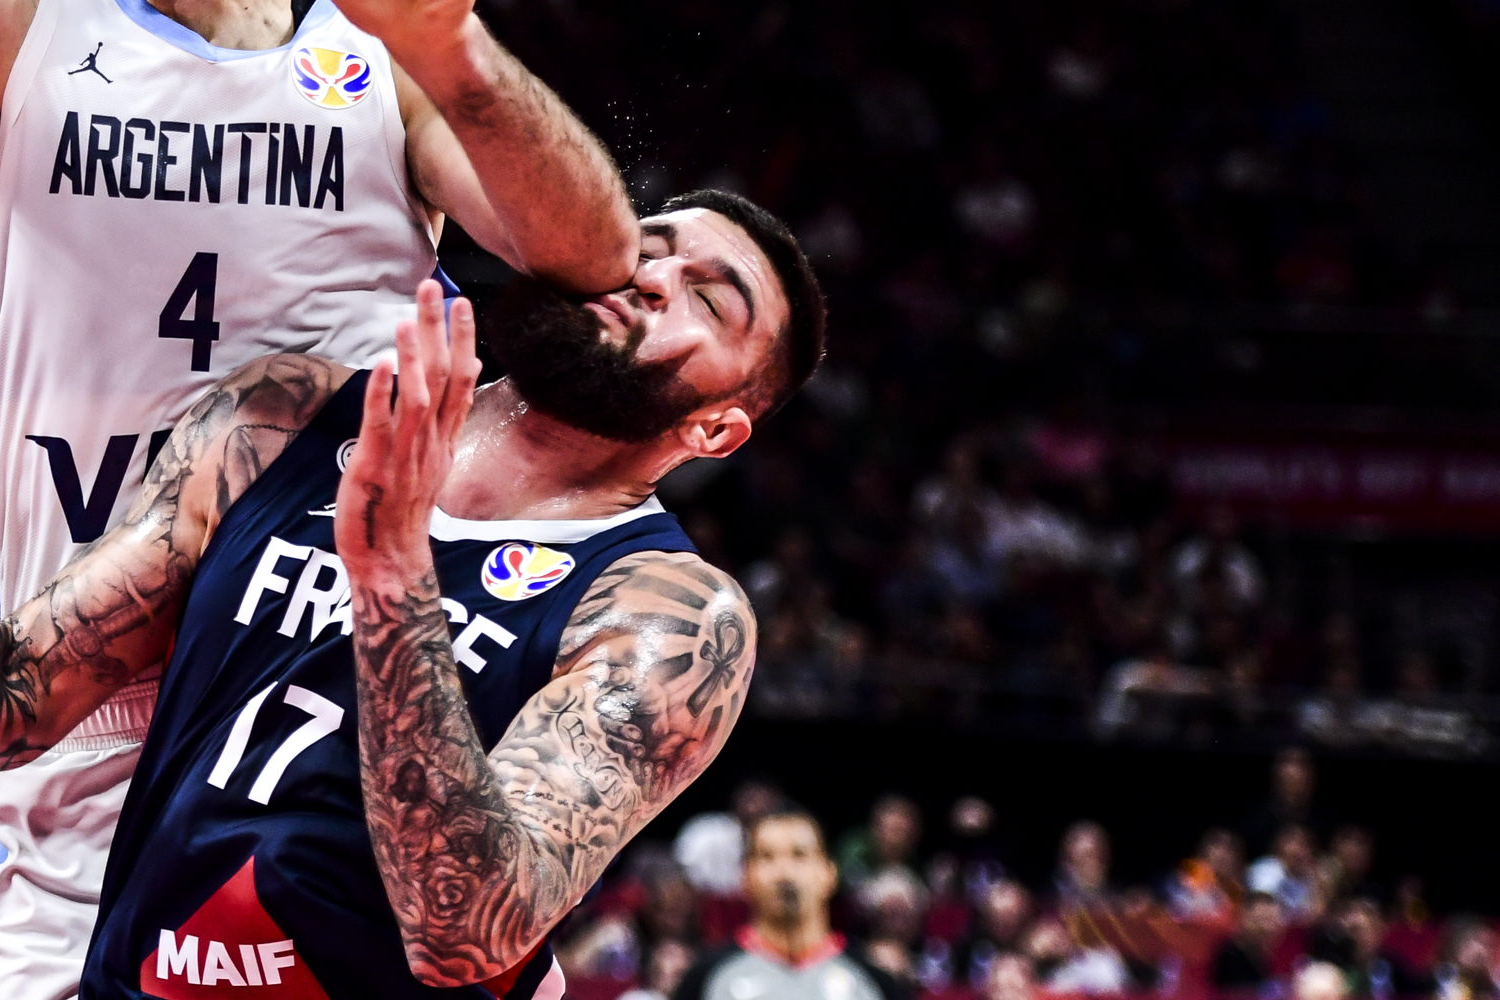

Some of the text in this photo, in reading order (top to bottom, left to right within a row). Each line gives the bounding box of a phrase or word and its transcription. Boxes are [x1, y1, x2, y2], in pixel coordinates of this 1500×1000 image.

[49, 110, 345, 212] ARGENTINA
[158, 251, 220, 372] 4
[207, 681, 345, 805] 17
[156, 928, 296, 987] MAIF
